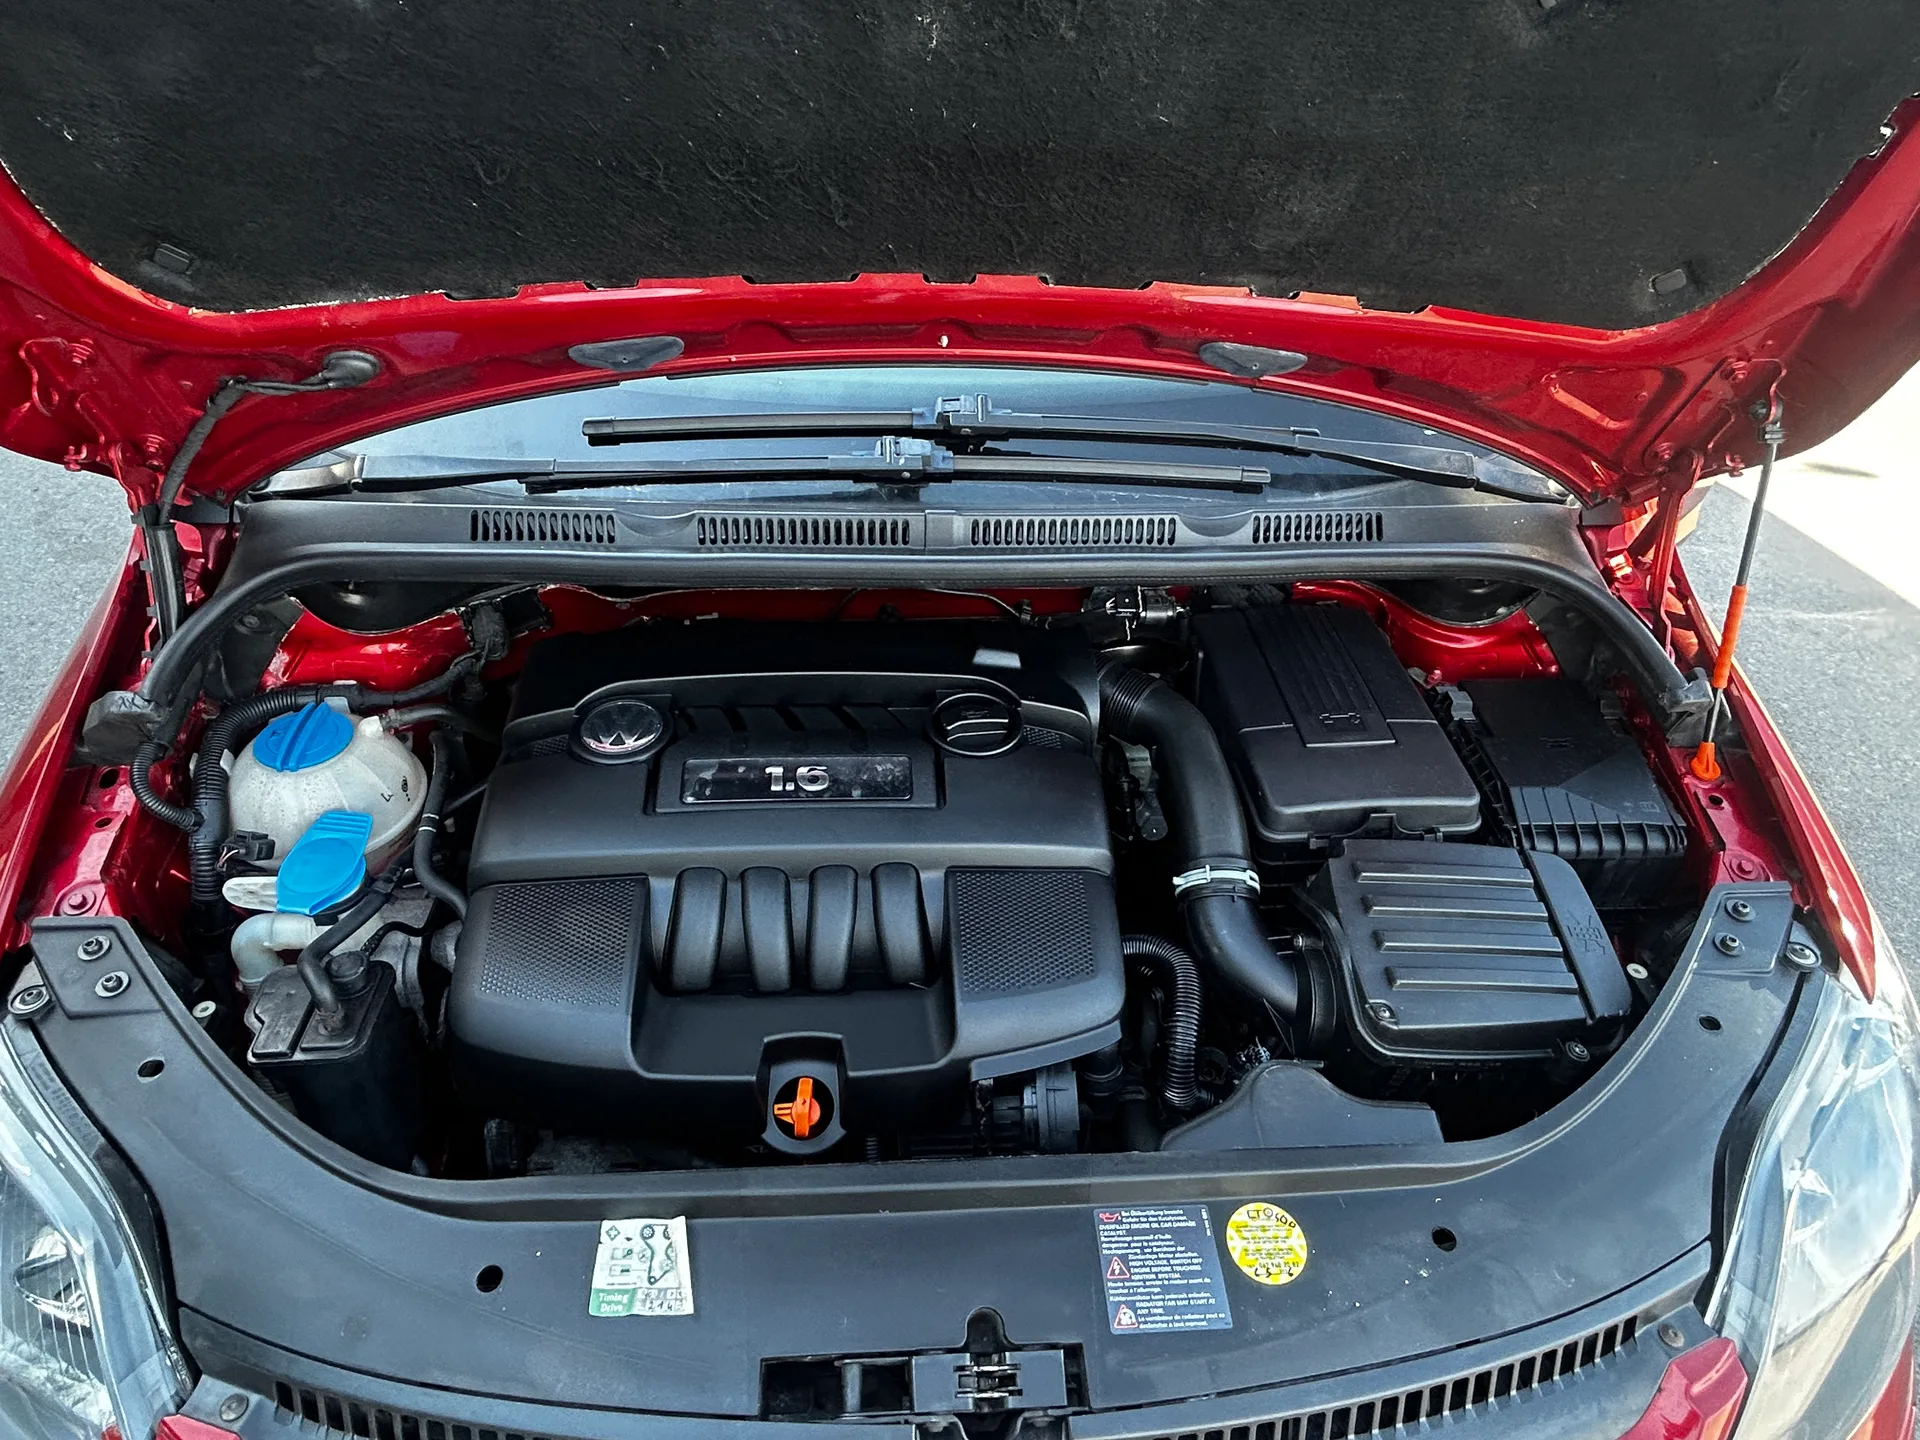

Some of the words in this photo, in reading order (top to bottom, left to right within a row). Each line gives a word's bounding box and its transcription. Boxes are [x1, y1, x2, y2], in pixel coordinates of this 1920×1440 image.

[765, 765, 830, 792] 1.6
[599, 1292, 630, 1304] Timing
[600, 1303, 624, 1313] Drive
